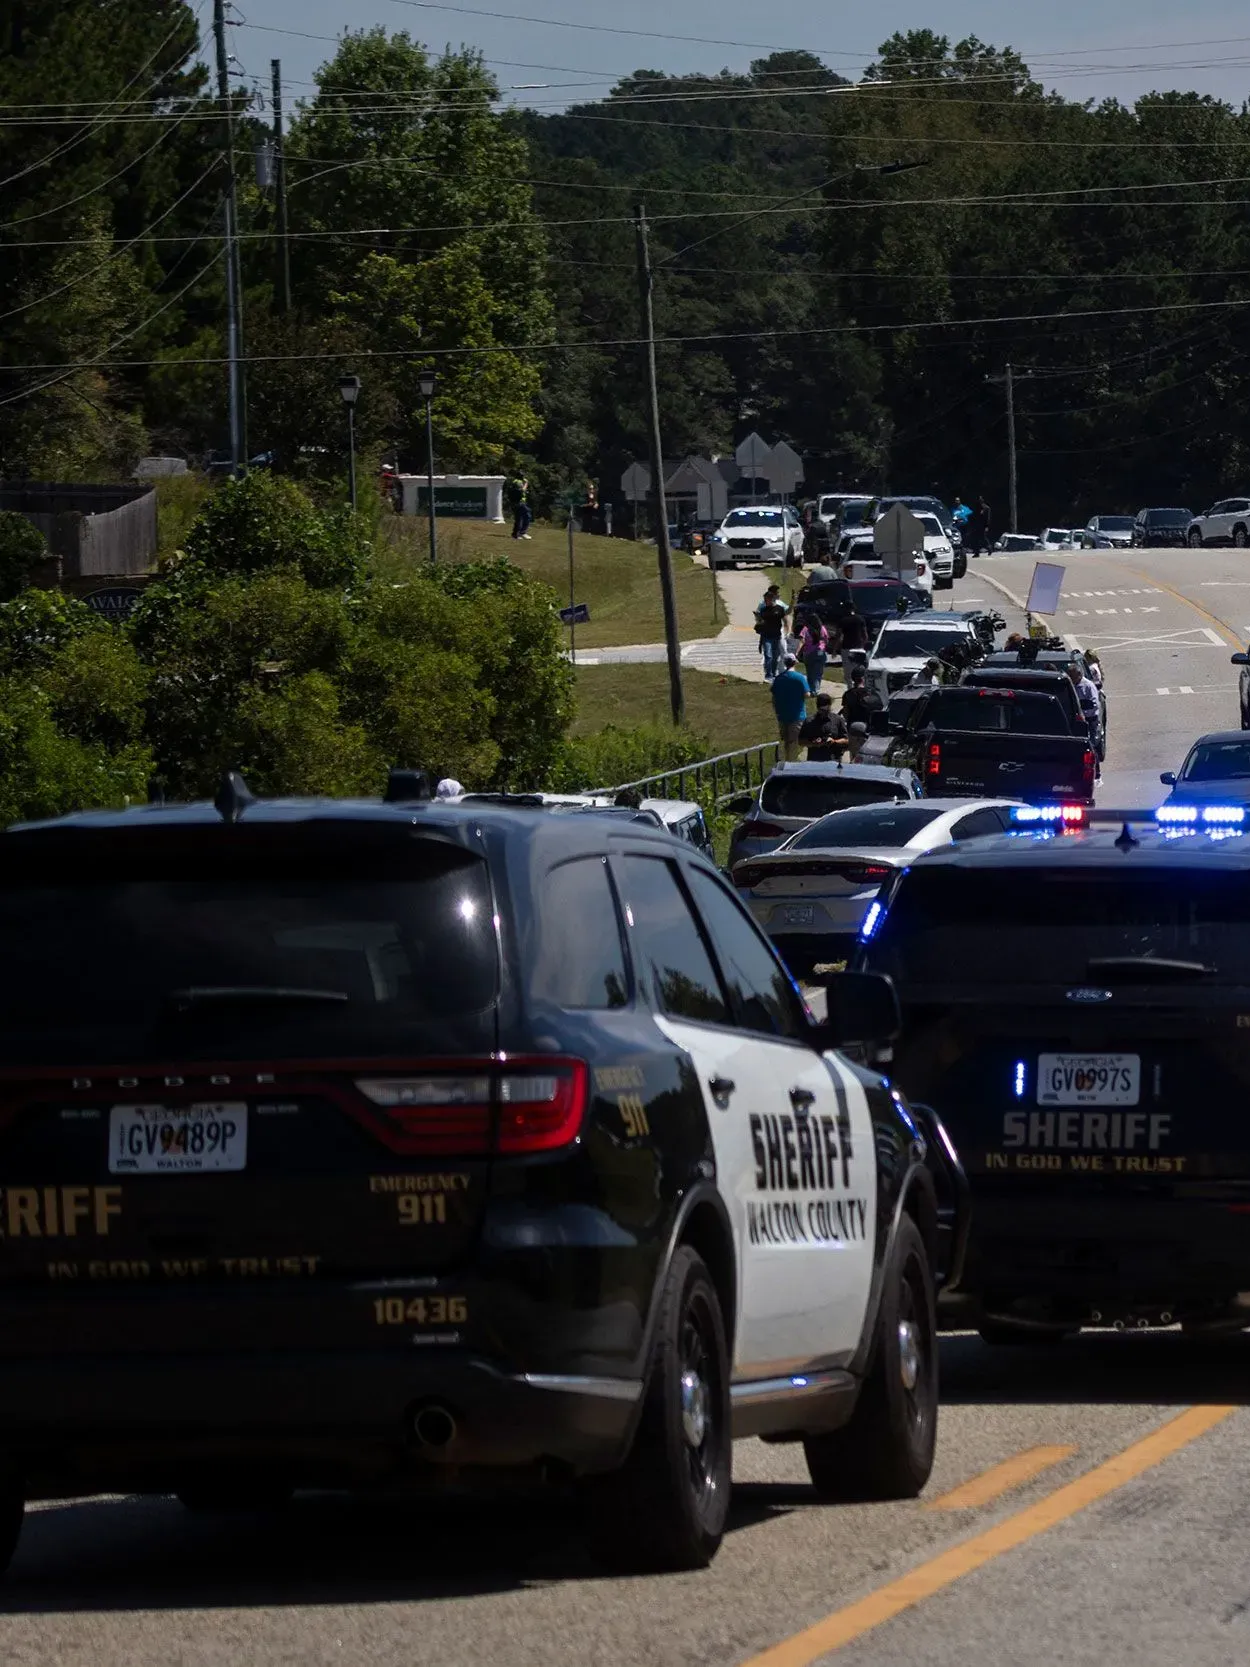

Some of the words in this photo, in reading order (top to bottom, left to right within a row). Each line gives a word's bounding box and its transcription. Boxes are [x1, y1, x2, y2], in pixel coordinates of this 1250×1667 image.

[89, 595, 138, 609] AVALO
[71, 1072, 276, 1090] DODGE
[1052, 1068, 1131, 1092] GV0997S
[617, 1092, 652, 1138] 911
[128, 1121, 236, 1156] GV9489P
[1002, 1111, 1172, 1150] SHERIFF
[157, 1159, 202, 1169] WALTON
[749, 1114, 853, 1190] SHERIFF
[985, 1152, 1008, 1169] IN
[1016, 1154, 1062, 1170] GOD
[1070, 1155, 1104, 1171] WE
[1111, 1156, 1187, 1173] TRUST
[369, 1172, 471, 1193] EMERGENCY
[0, 1185, 122, 1238] RIFF
[397, 1193, 448, 1225] 911
[747, 1200, 808, 1245] WALTON
[807, 1198, 867, 1242] COUNTY
[47, 1262, 79, 1281] IN
[374, 1296, 468, 1326] 10436
